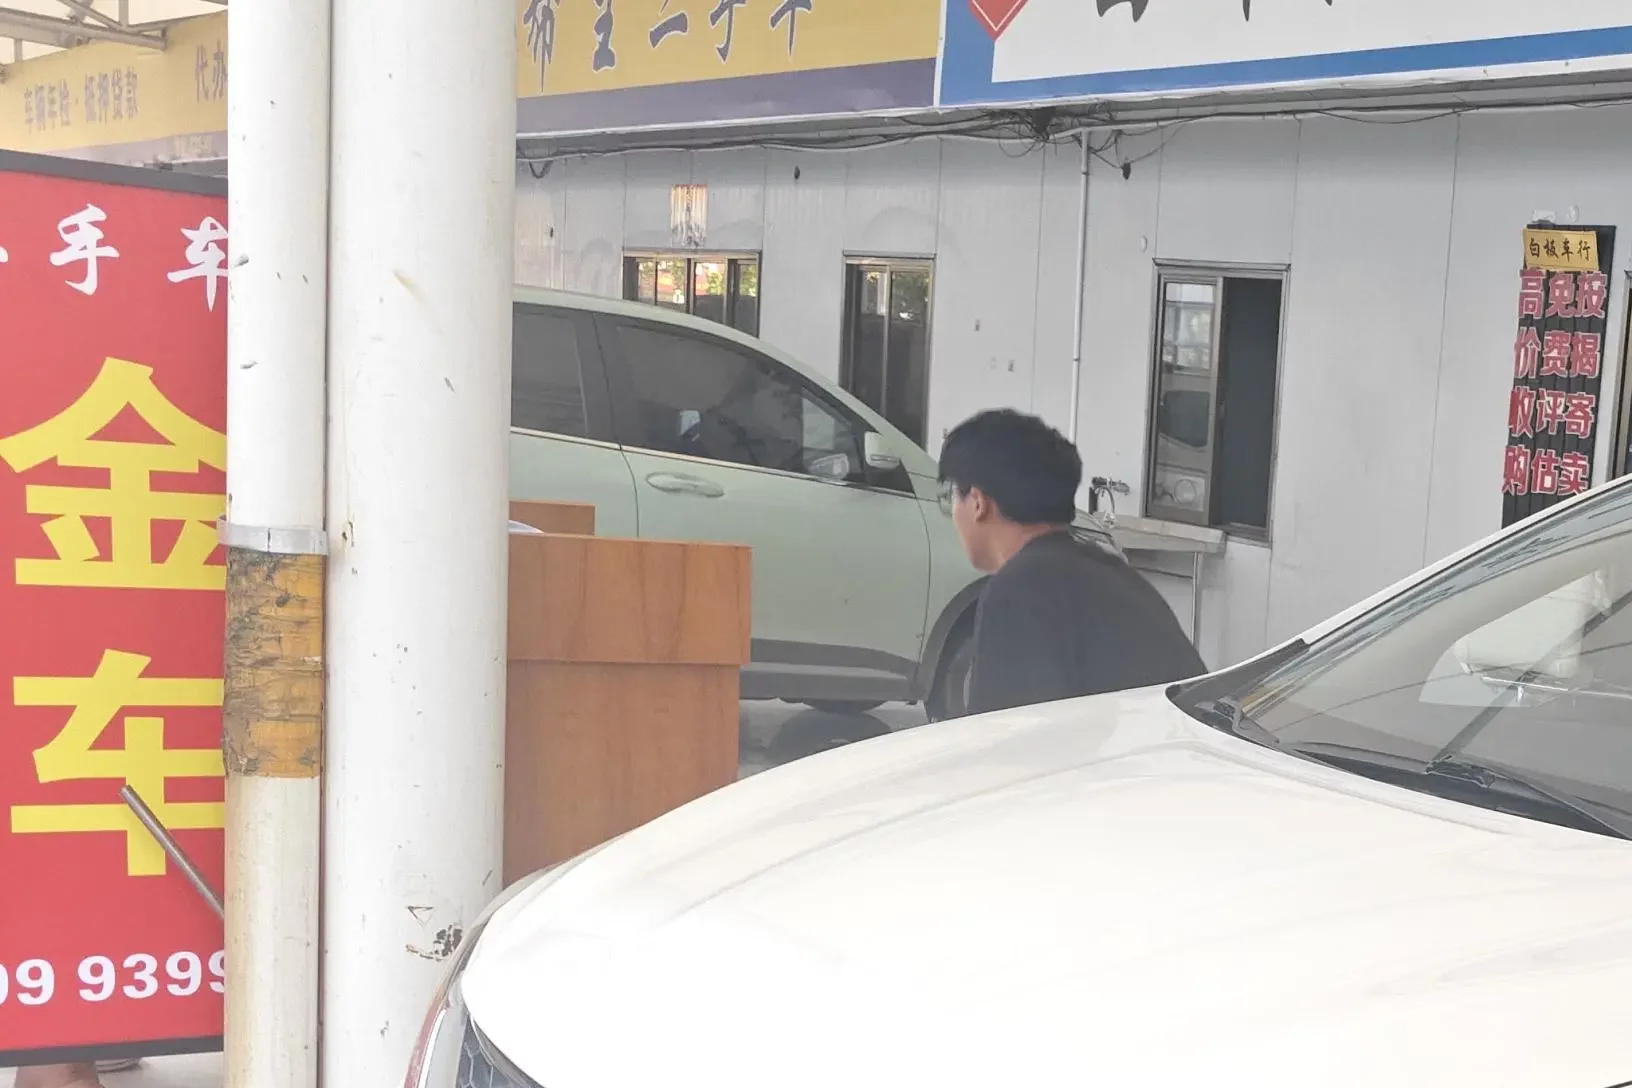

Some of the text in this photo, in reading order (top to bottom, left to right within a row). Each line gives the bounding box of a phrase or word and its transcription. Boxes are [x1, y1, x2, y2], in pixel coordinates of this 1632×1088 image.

[0, 202, 228, 312] 手车
[1501, 266, 1547, 496] 高价收购
[1530, 270, 1578, 496] 免费评估
